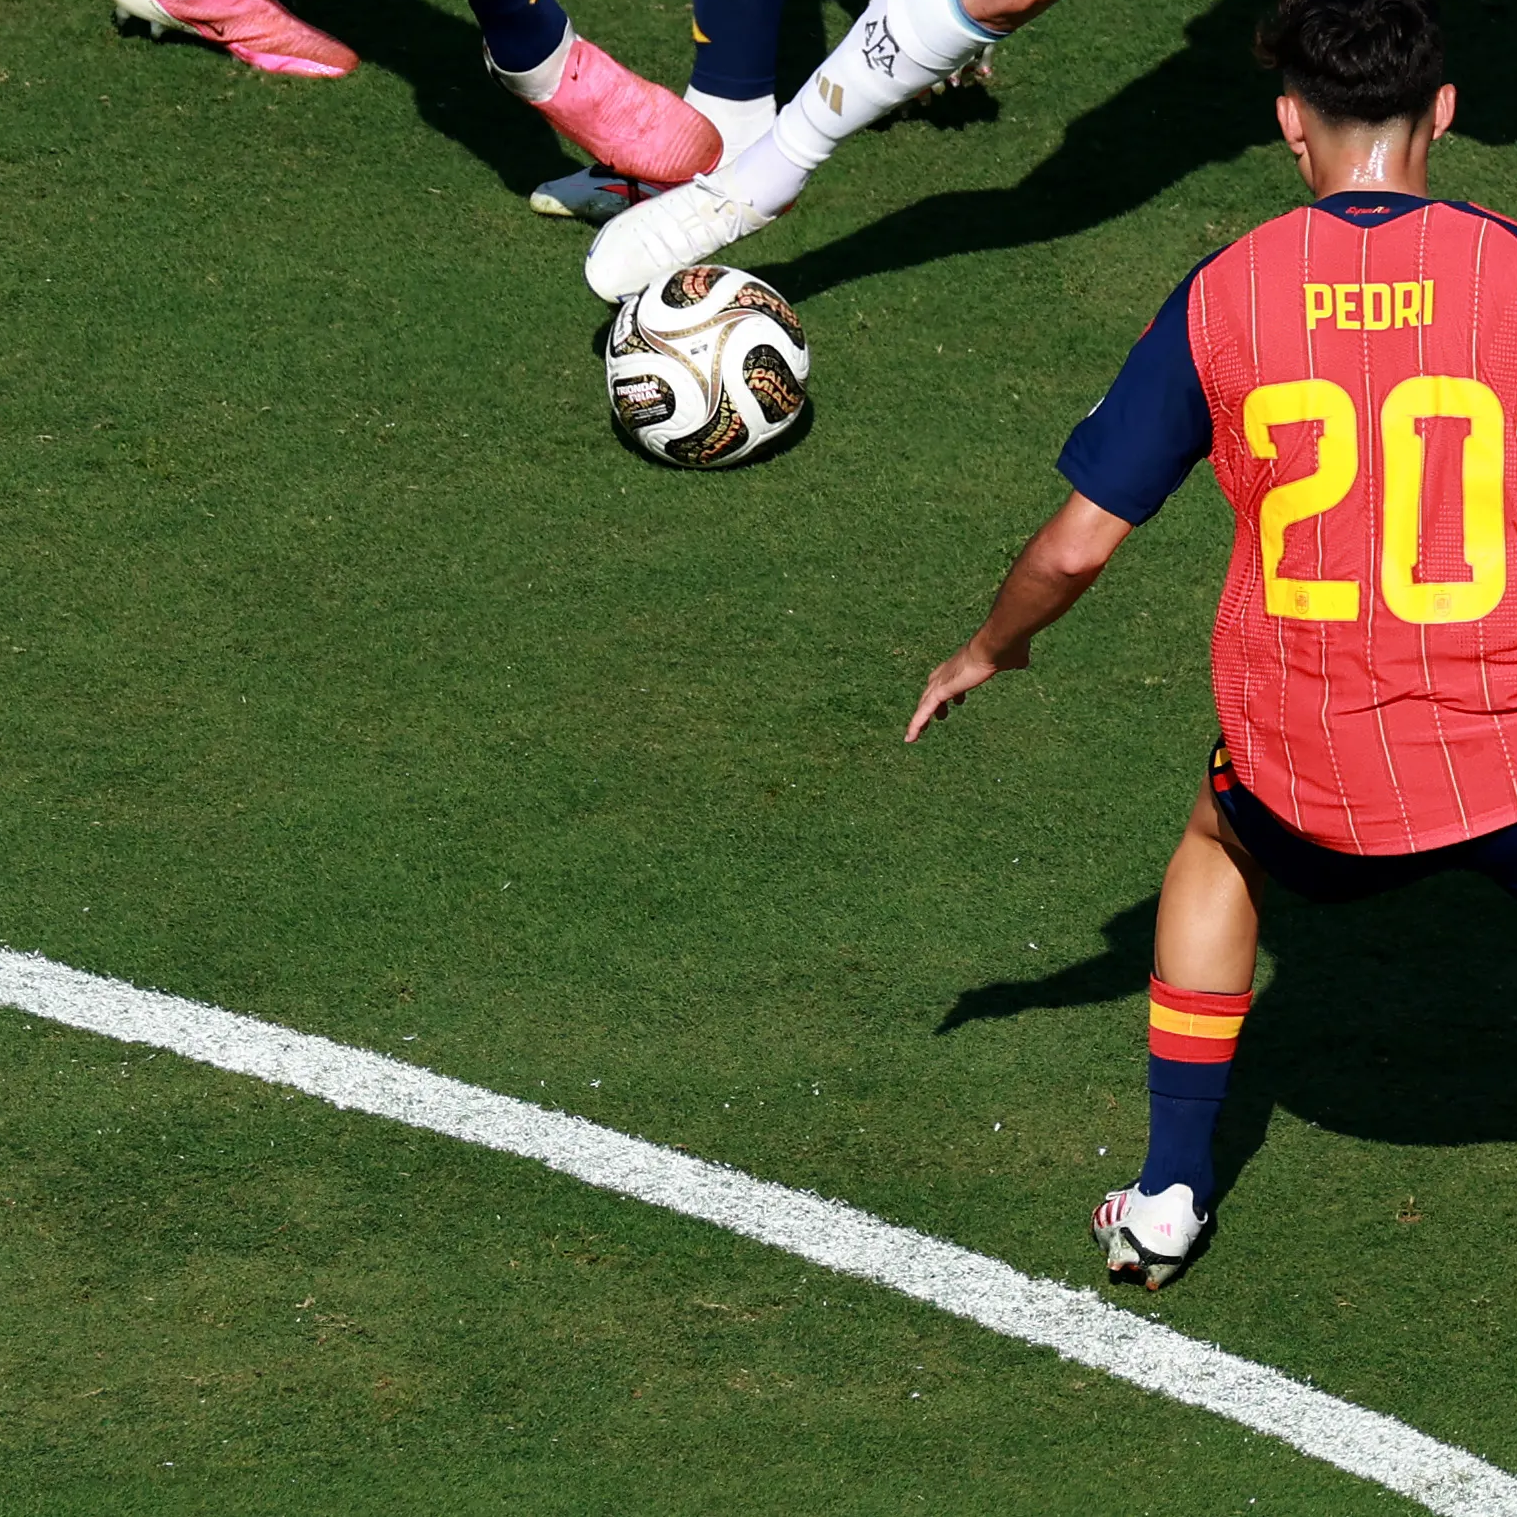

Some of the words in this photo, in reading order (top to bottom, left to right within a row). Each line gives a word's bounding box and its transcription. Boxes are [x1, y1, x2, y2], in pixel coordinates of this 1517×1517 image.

[862, 14, 900, 79] AFA
[1303, 279, 1435, 331] PEDRI
[615, 381, 660, 396] TRIONDA
[627, 389, 663, 403] FINAL
[1243, 375, 1507, 625] 20
